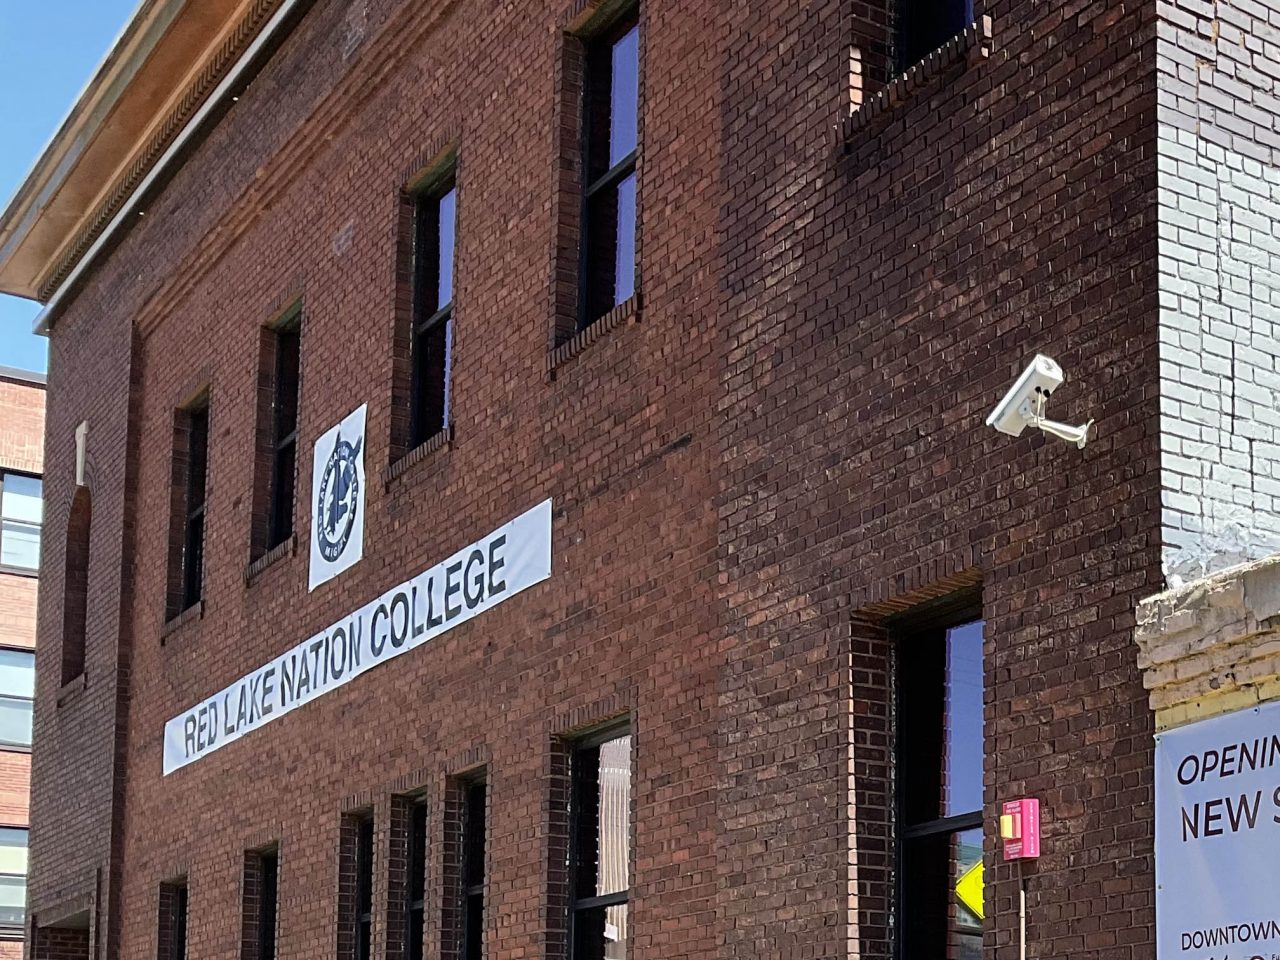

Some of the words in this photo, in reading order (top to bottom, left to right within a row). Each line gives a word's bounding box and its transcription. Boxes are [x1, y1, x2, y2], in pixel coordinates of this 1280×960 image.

[184, 702, 218, 758] RED
[224, 668, 275, 736] LAKE
[280, 617, 363, 707] NATION
[370, 534, 507, 658] COLLEGE
[1180, 790, 1264, 842] NEW
